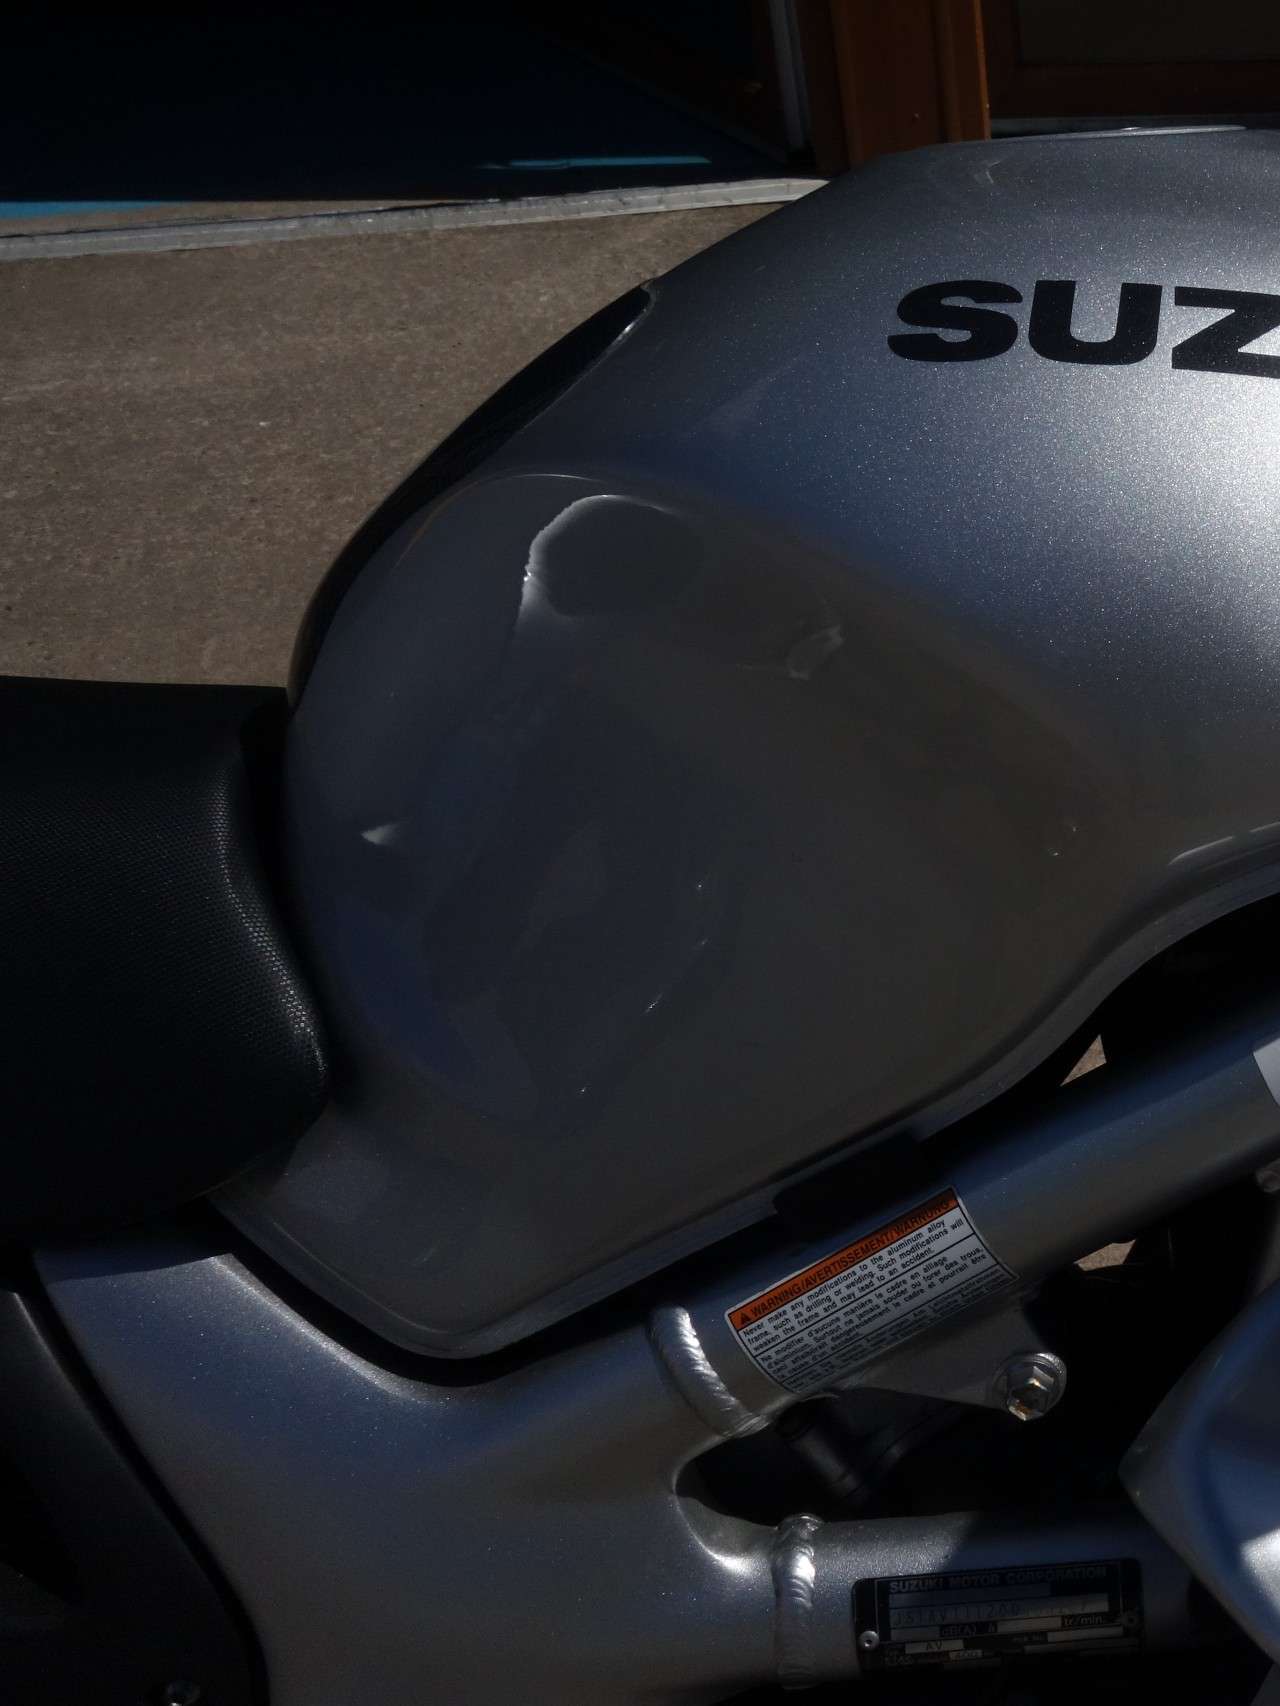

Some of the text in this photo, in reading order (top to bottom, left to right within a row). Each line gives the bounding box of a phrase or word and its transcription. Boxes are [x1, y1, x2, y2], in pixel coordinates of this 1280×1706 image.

[742, 1219, 945, 1337] Never make any modifications to the aluminum alloy
[753, 1334, 780, 1351] weaken
[782, 1325, 795, 1335] the
[797, 1311, 819, 1326] frame
[822, 1300, 837, 1312] and
[839, 1291, 856, 1303] may
[857, 1279, 874, 1293] lead
[875, 1274, 885, 1282] to
[888, 1267, 897, 1276] an
[772, 1317, 791, 1330] such
[793, 1310, 803, 1319] as
[805, 1294, 832, 1312] drilling
[833, 1288, 842, 1296] or
[844, 1270, 875, 1290] welding.
[876, 1257, 896, 1271] Such
[898, 1228, 948, 1259] modifications
[950, 1218, 963, 1230] will
[885, 1278, 907, 1293] cadre
[909, 1271, 920, 1280] en
[888, 1578, 944, 1593] SUZUKI
